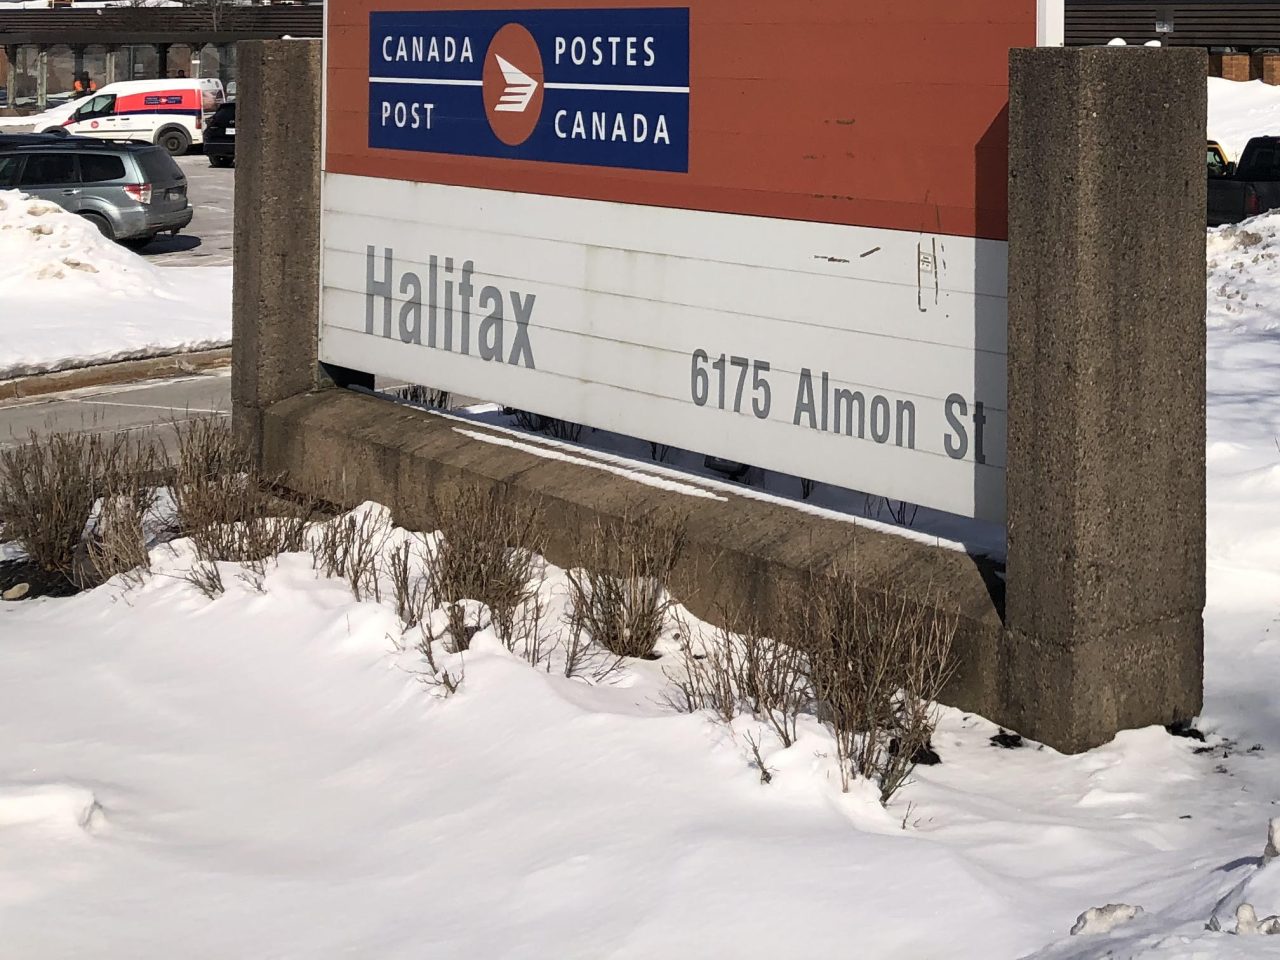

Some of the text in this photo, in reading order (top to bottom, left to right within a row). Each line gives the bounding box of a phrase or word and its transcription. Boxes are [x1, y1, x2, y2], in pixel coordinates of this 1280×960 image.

[382, 35, 474, 63] CANADA
[554, 36, 656, 67] POSTES
[381, 101, 435, 130] POST
[554, 109, 671, 145] CANADA
[365, 244, 537, 370] Halifax
[691, 348, 987, 464] 6175 Almon St
